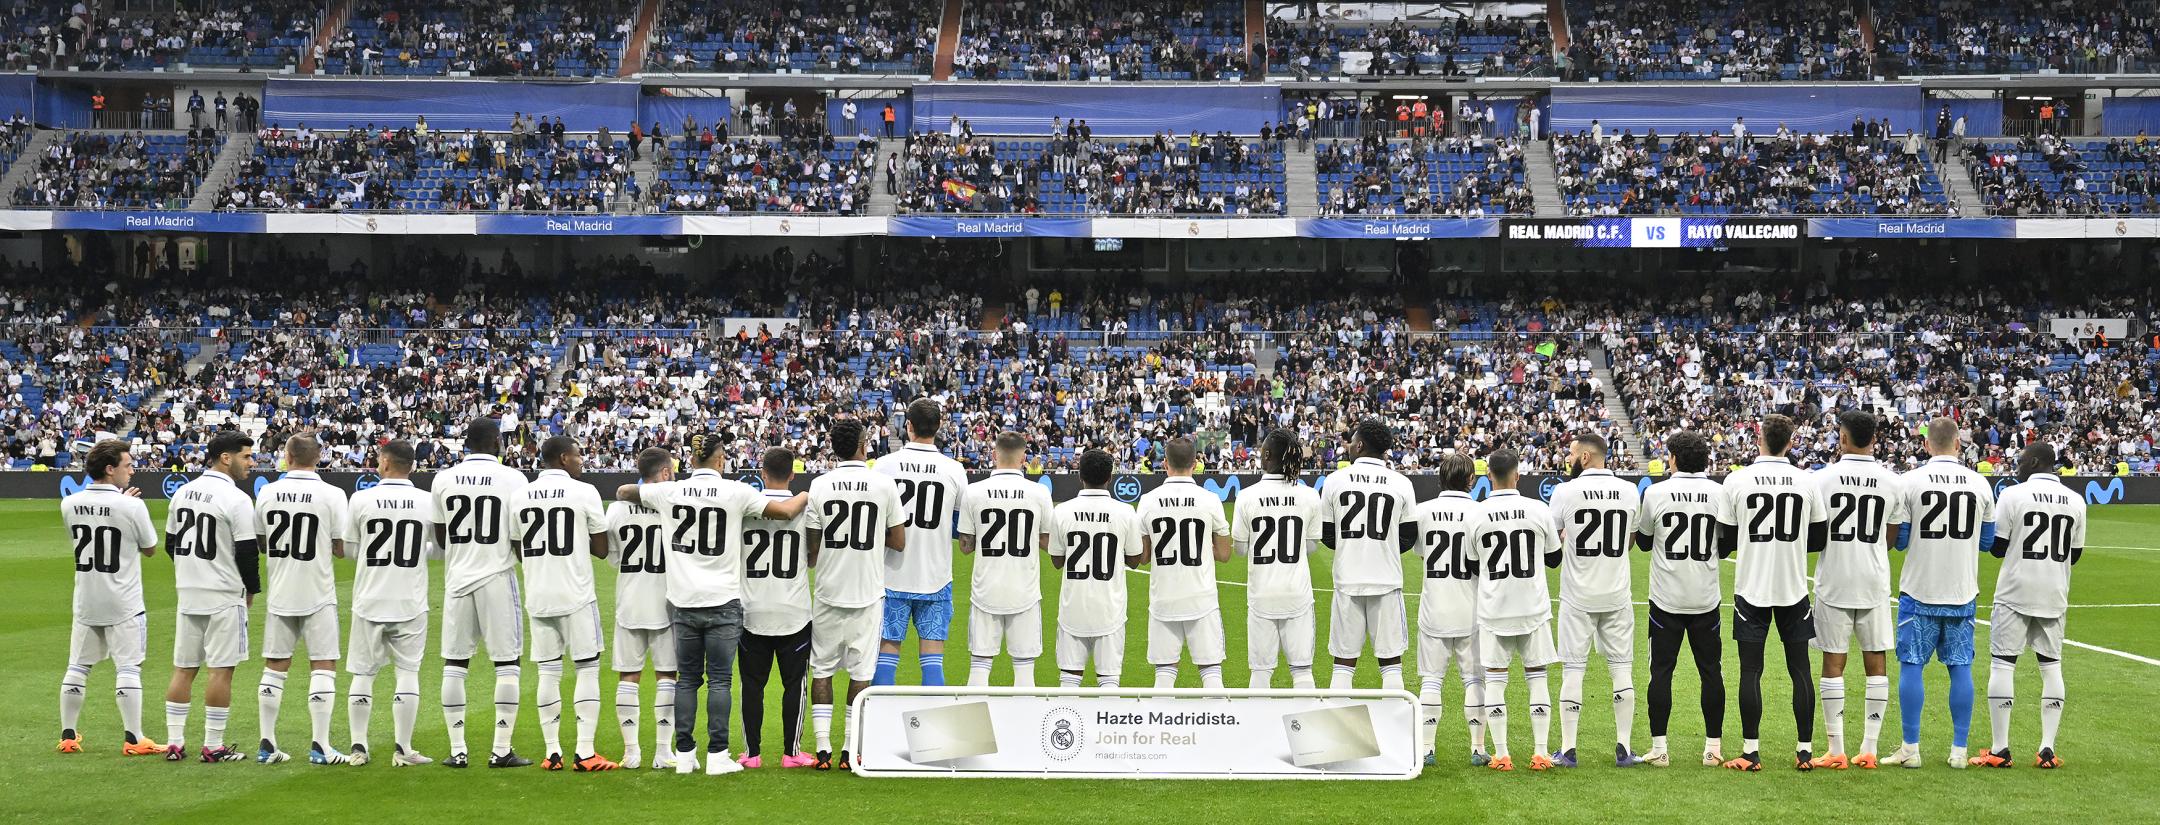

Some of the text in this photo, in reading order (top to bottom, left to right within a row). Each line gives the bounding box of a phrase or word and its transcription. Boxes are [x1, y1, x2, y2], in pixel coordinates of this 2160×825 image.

[126, 216, 194, 226] Real Madrid
[547, 220, 612, 231] Real Madrid
[957, 222, 1022, 232] Real Madrid
[1879, 223, 1945, 233] Real Madrid
[1365, 224, 1430, 234] Real Madrid
[1509, 225, 1623, 239] REAL MADRID C.F.
[1646, 226, 1665, 240] VS
[1687, 225, 1798, 239] RAYO VALLECANO
[899, 462, 920, 473] VINI
[455, 476, 476, 485] VINI
[1349, 473, 1370, 483] VINI
[1754, 476, 1777, 485] VINI
[1840, 475, 1861, 486] VINI
[1928, 474, 1949, 484] VINI
[832, 482, 851, 491] VINI
[1118, 482, 1138, 496] 5G
[1543, 484, 1556, 496] 5
[276, 492, 296, 503] VINI
[528, 489, 547, 499] VINI
[987, 489, 1009, 499] VINI
[1582, 490, 1603, 500] VINI
[1671, 492, 1692, 502] VINI
[2032, 493, 2052, 504] VINI
[377, 500, 397, 509] VINI
[894, 479, 945, 529] 20
[1159, 497, 1180, 507] VINI
[1259, 496, 1279, 507] VINI
[74, 506, 95, 515] VINI
[1074, 511, 1095, 522] VINI
[1340, 491, 1394, 540] 20
[1432, 511, 1464, 521] VINI J
[1488, 510, 1509, 522] VINI
[1747, 493, 1803, 542] 20
[1920, 491, 1977, 539] 20
[446, 495, 501, 544] 20
[823, 500, 878, 550] 20
[1830, 493, 1885, 543] 20
[175, 508, 216, 561] 20
[266, 510, 319, 561] 20
[520, 507, 575, 557] 20
[672, 505, 727, 556] 20
[981, 508, 1034, 557] 20
[1575, 509, 1628, 557] 20
[1662, 512, 1717, 561] 20
[2022, 511, 2074, 562] 20
[366, 518, 422, 567] 20
[1152, 517, 1205, 566] 20
[1251, 515, 1303, 564] 20
[71, 525, 121, 573] 20
[619, 525, 666, 573] 20
[743, 529, 800, 579] 20
[1067, 531, 1118, 581] 20
[1426, 531, 1472, 580] 20
[1481, 529, 1536, 580] 20
[1096, 711, 1240, 725] Hazte Madridista.
[1096, 731, 1196, 745] Join for Real
[1095, 752, 1167, 760] madridistas.com
